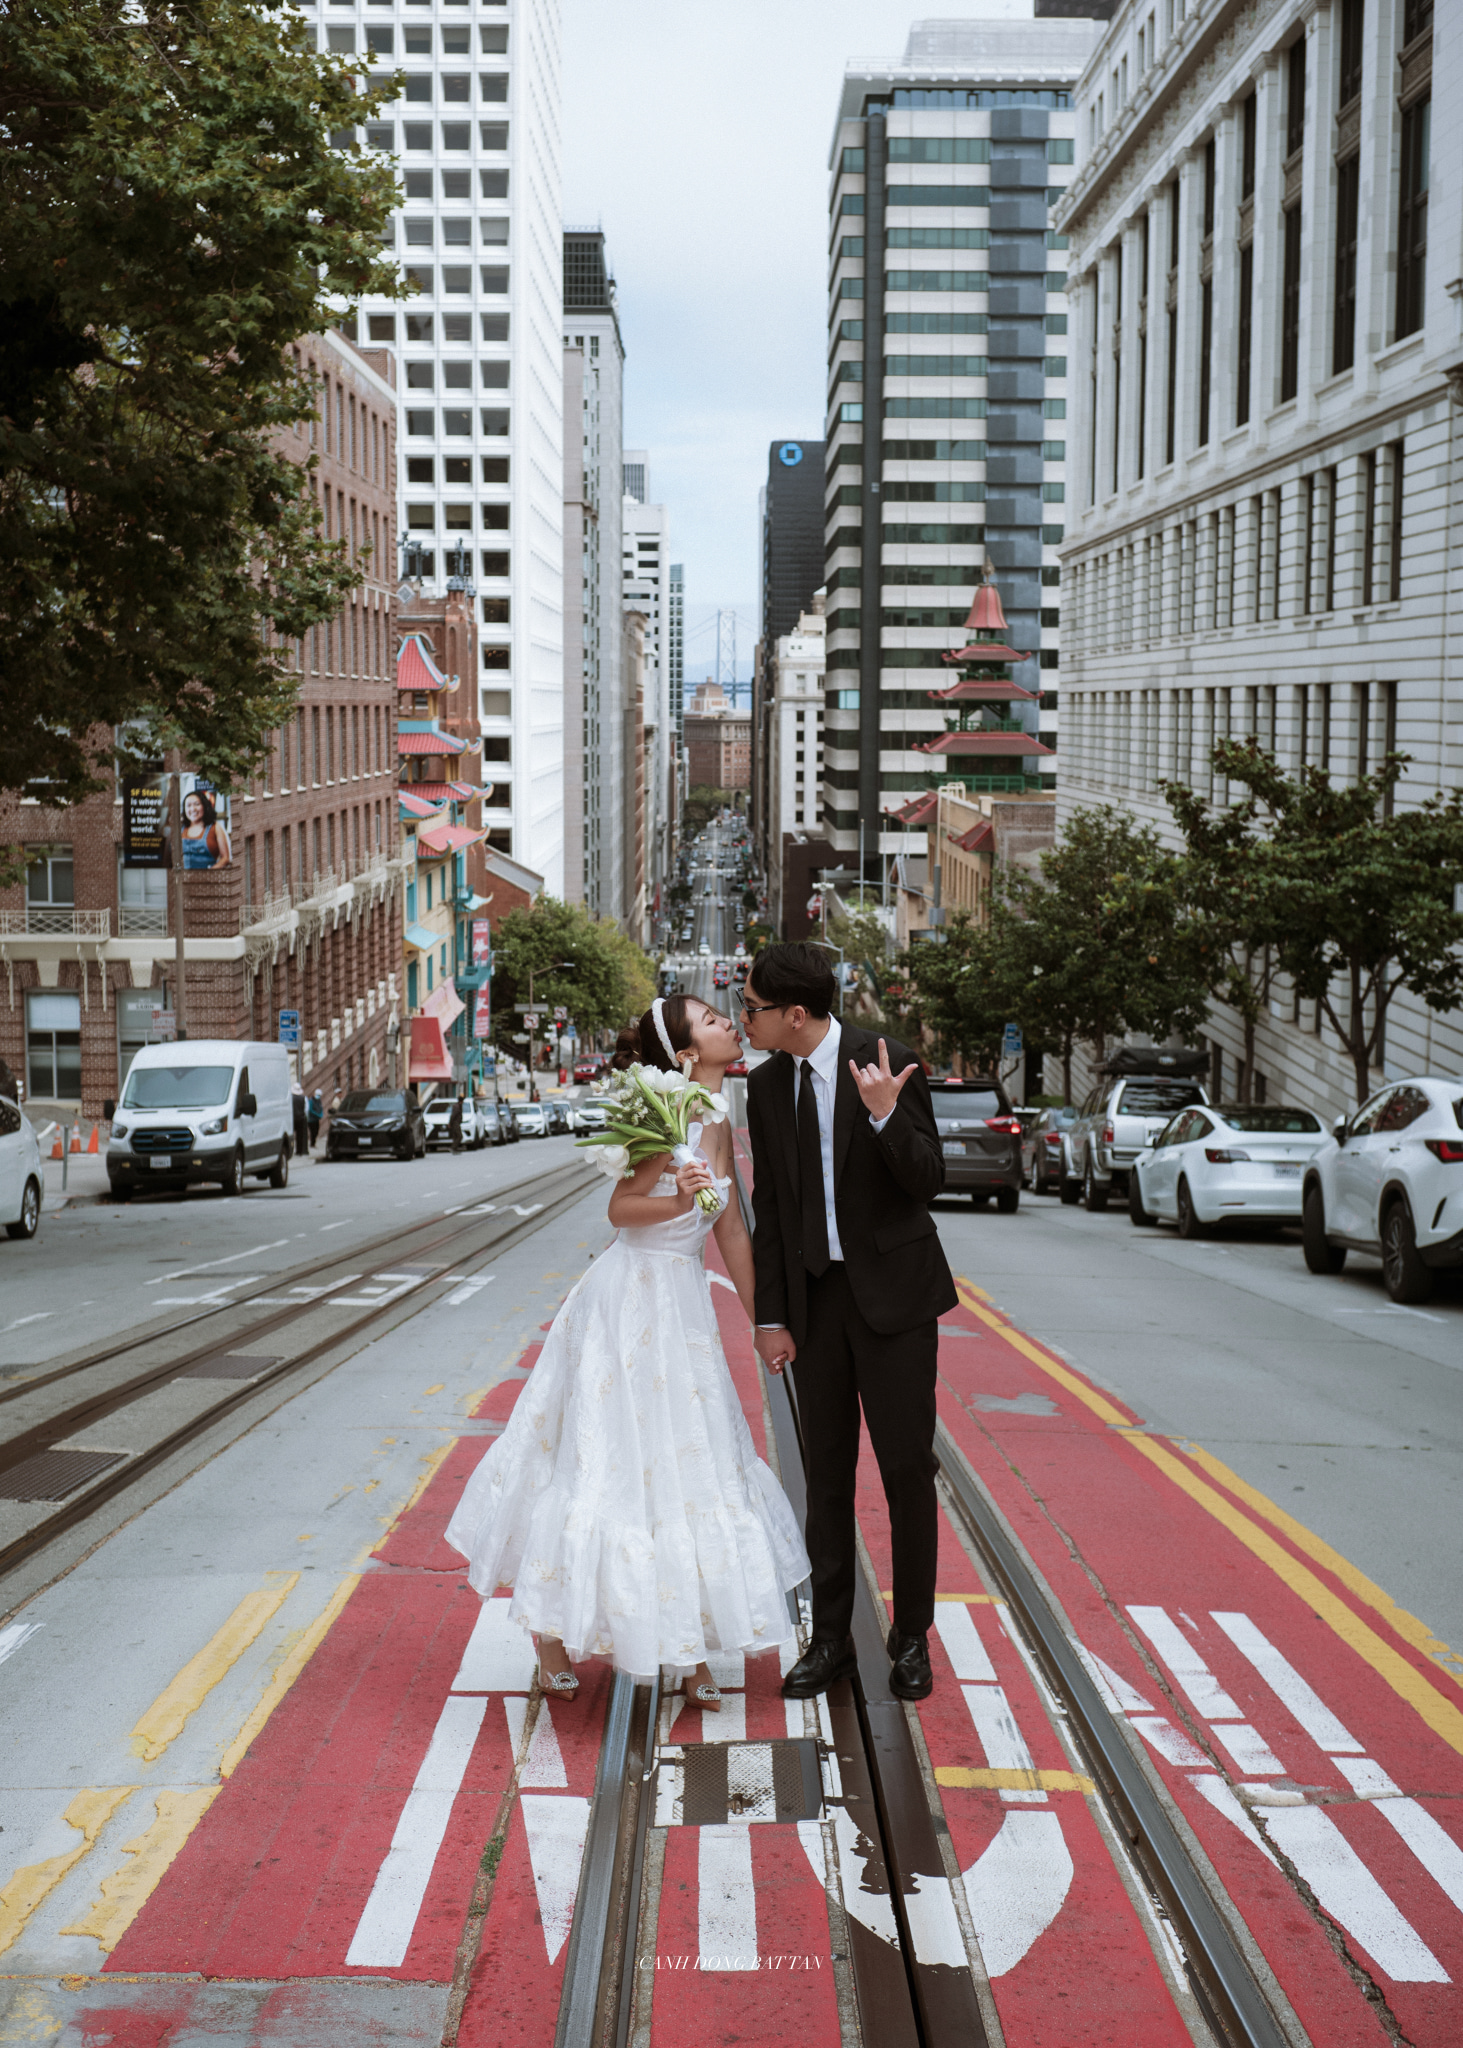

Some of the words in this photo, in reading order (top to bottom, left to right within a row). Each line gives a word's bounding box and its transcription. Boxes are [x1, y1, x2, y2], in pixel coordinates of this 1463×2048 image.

[130, 788, 140, 796] SF
[142, 788, 162, 796] State
[130, 797, 138, 806] is
[139, 797, 162, 806] where
[135, 807, 156, 815] made
[137, 816, 161, 824] better
[130, 825, 155, 834] world.
[151, 1274, 496, 1306] LEFT
